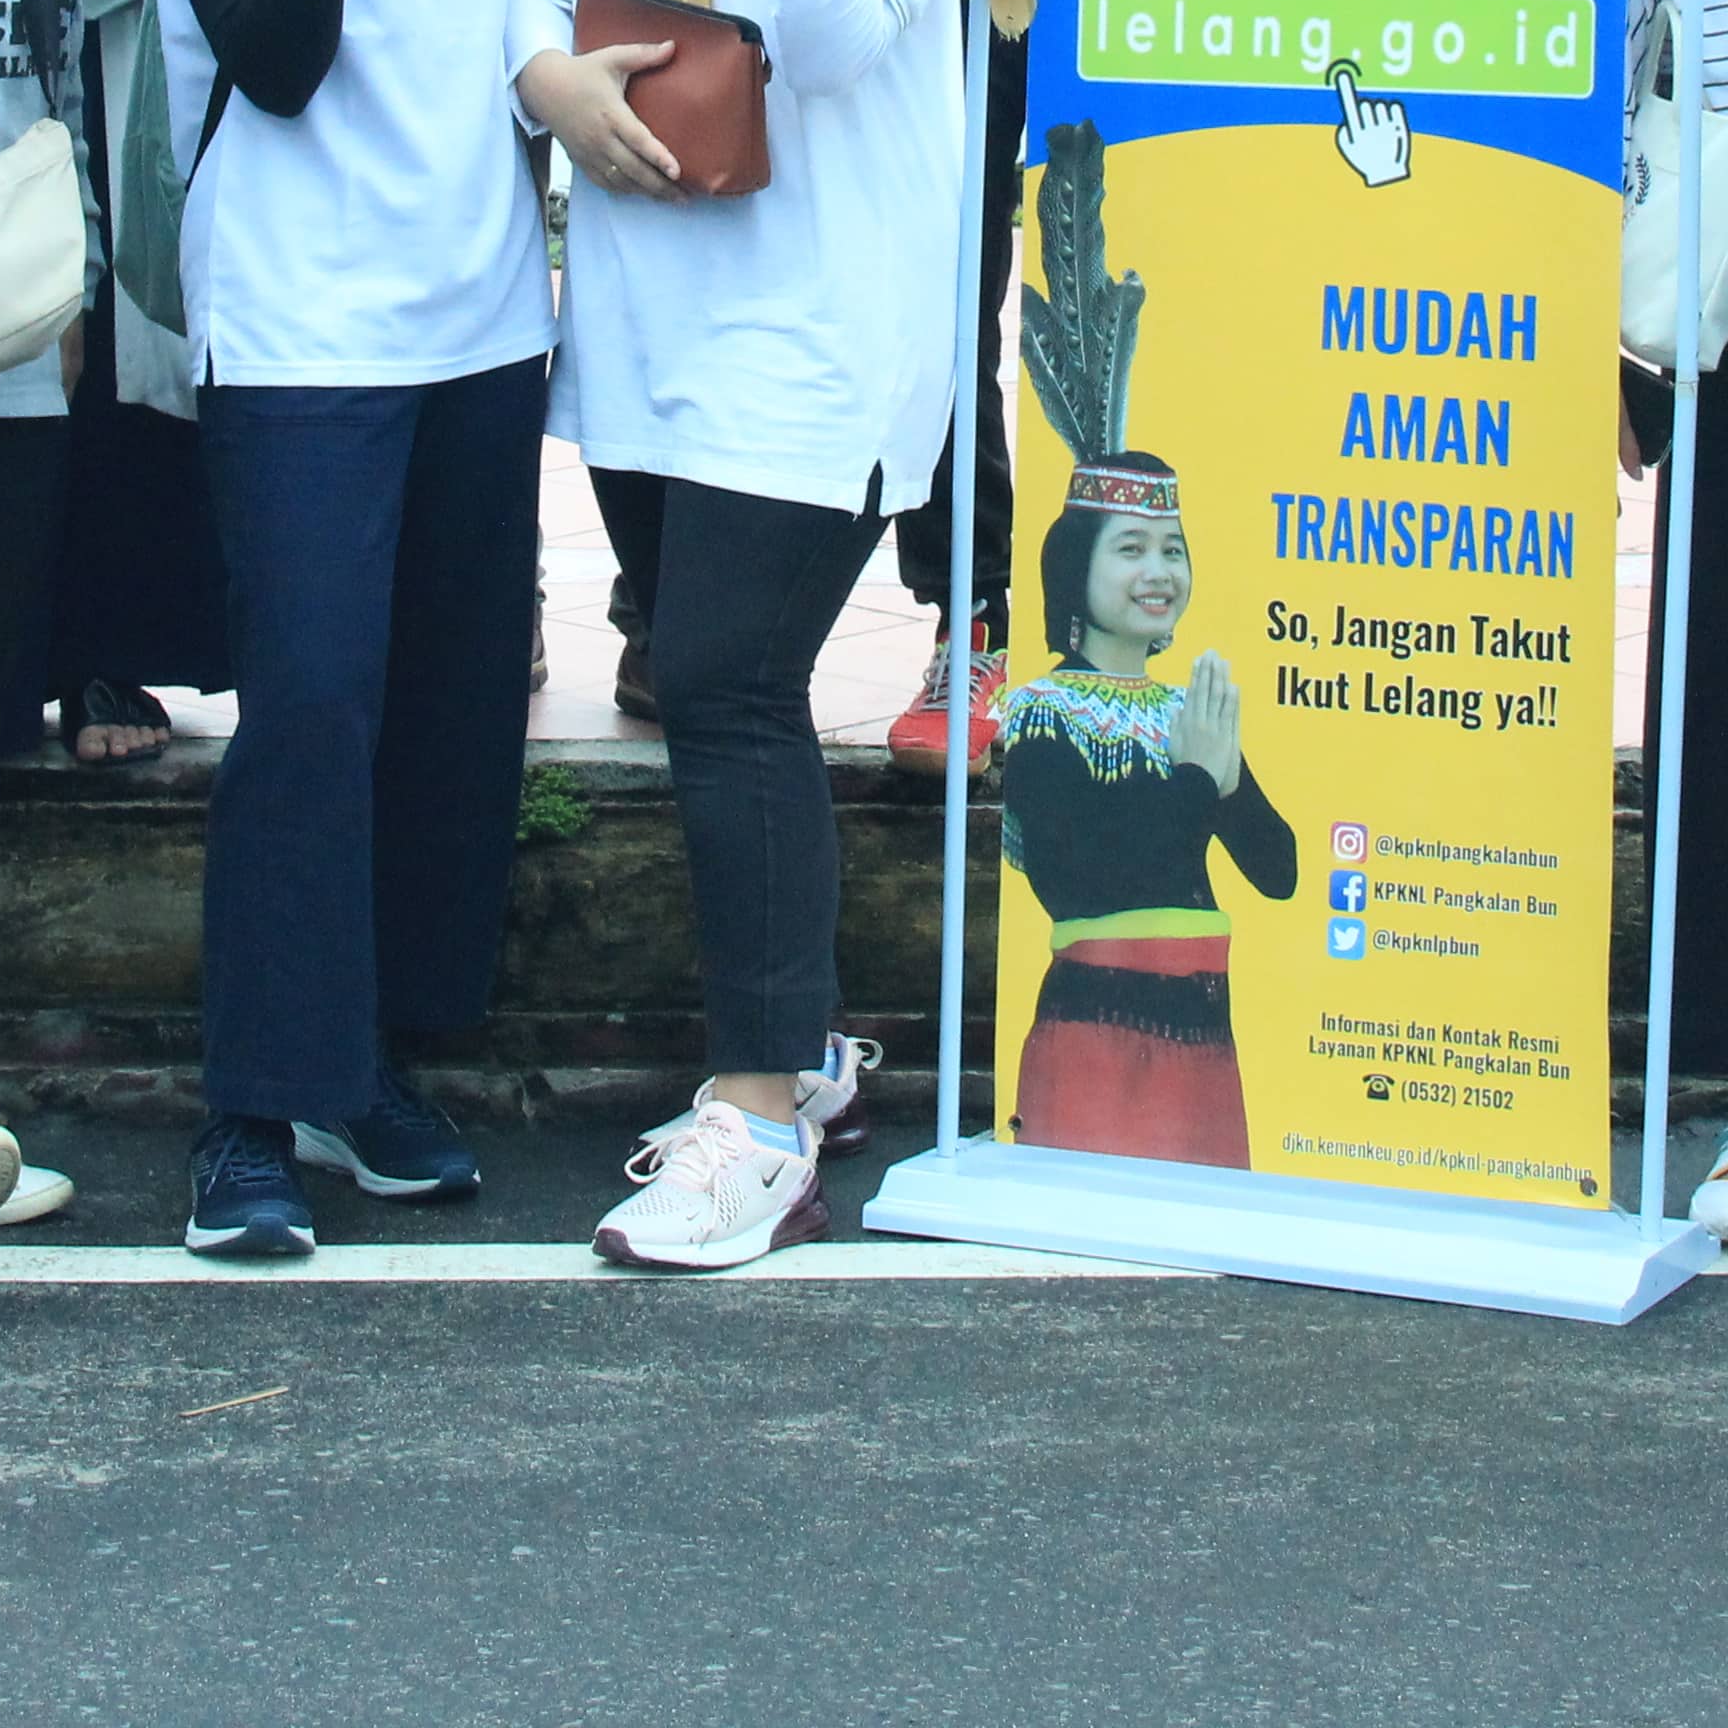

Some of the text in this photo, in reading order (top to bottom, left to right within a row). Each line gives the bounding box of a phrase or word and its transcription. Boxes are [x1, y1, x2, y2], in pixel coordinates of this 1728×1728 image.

[1321, 284, 1537, 362] MUDAH
[1340, 391, 1510, 467] AMAN
[1271, 491, 1574, 579] TRANSPARAN
[1266, 600, 1572, 663] So, Jangan Takut
[1277, 665, 1558, 731] Ikut Lelang ya!!
[1375, 834, 1559, 869] @kpknlpangkalanbun
[1374, 881, 1558, 916] KPKNL Pangkalan Bun
[1372, 929, 1480, 957] @kpknlpbun
[1321, 1012, 1560, 1054] Informasi dan Kontak Resmi
[1309, 1035, 1571, 1080] Layanan KPKNL Pangkalan Bun
[1401, 1080, 1514, 1110] (0532) 21502
